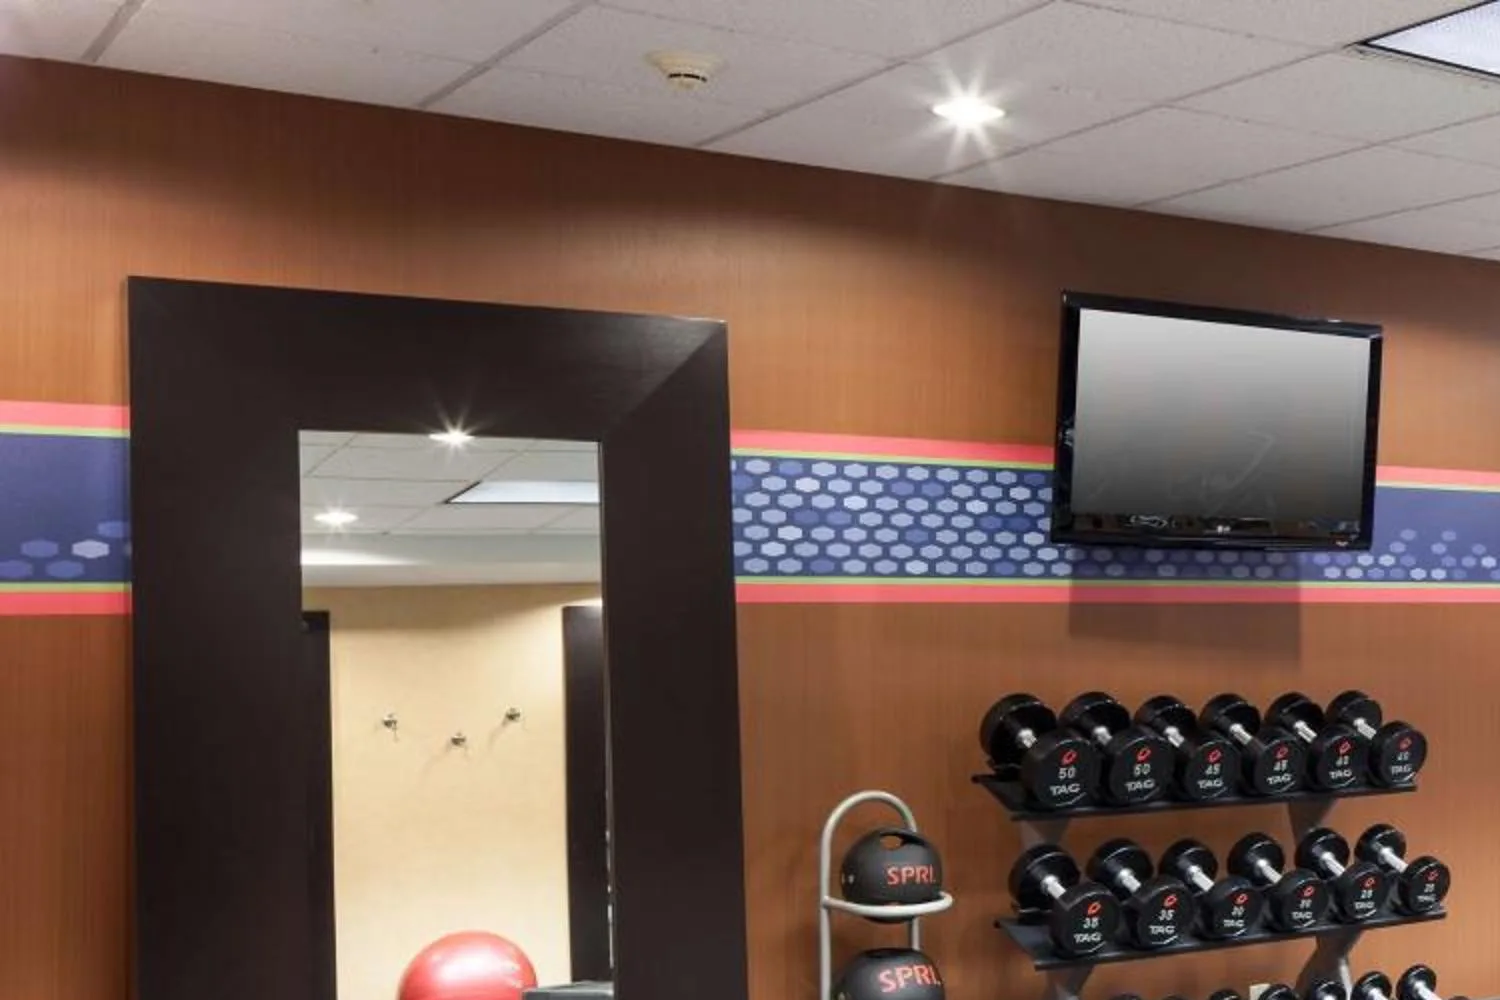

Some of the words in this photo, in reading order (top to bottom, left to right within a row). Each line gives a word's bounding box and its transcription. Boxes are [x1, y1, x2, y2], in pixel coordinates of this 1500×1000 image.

[1058, 767, 1076, 780] 50
[1205, 763, 1221, 776] 45
[1328, 769, 1353, 780] TAG
[1390, 764, 1413, 774] TAG
[1125, 779, 1155, 792] TAG
[1197, 779, 1224, 789] TAG
[1266, 774, 1292, 785] TAG
[1049, 783, 1081, 796] TAG
[887, 865, 934, 886] SPRI
[1158, 909, 1175, 921] 35
[1291, 911, 1313, 920] TAG
[1223, 919, 1245, 928] TAG
[1149, 925, 1175, 935] TAG
[1073, 932, 1102, 944] TAG
[879, 964, 938, 993] SPRI
